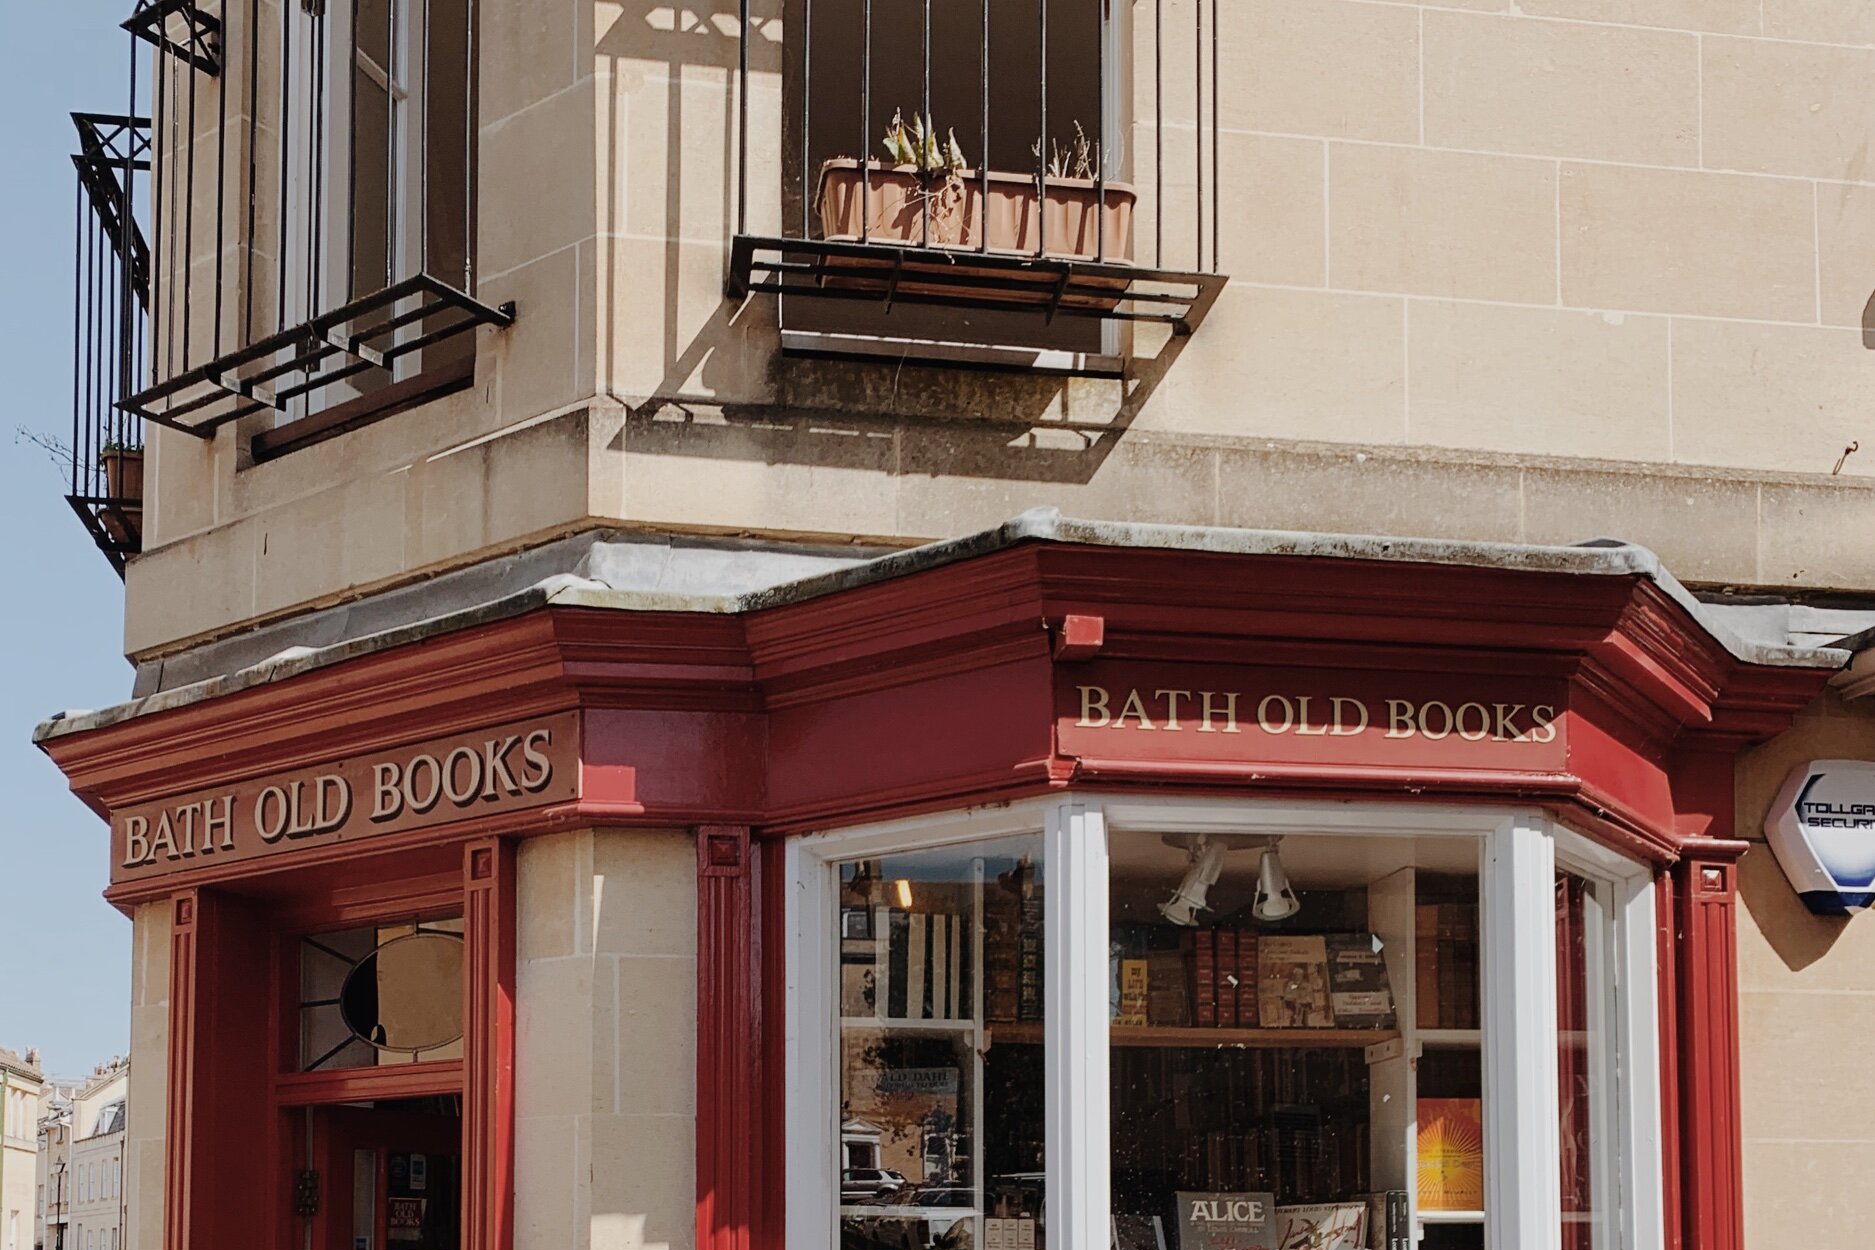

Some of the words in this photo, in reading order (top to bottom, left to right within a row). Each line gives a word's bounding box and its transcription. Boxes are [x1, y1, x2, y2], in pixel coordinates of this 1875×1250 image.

[1074, 685, 1241, 734] BATH
[1257, 694, 1369, 737] OLD
[1384, 698, 1558, 743] BOOKS
[122, 796, 236, 868] BATH
[254, 773, 352, 841] OLD
[369, 728, 553, 823] BOOKS
[1190, 1200, 1266, 1222] ALICE
